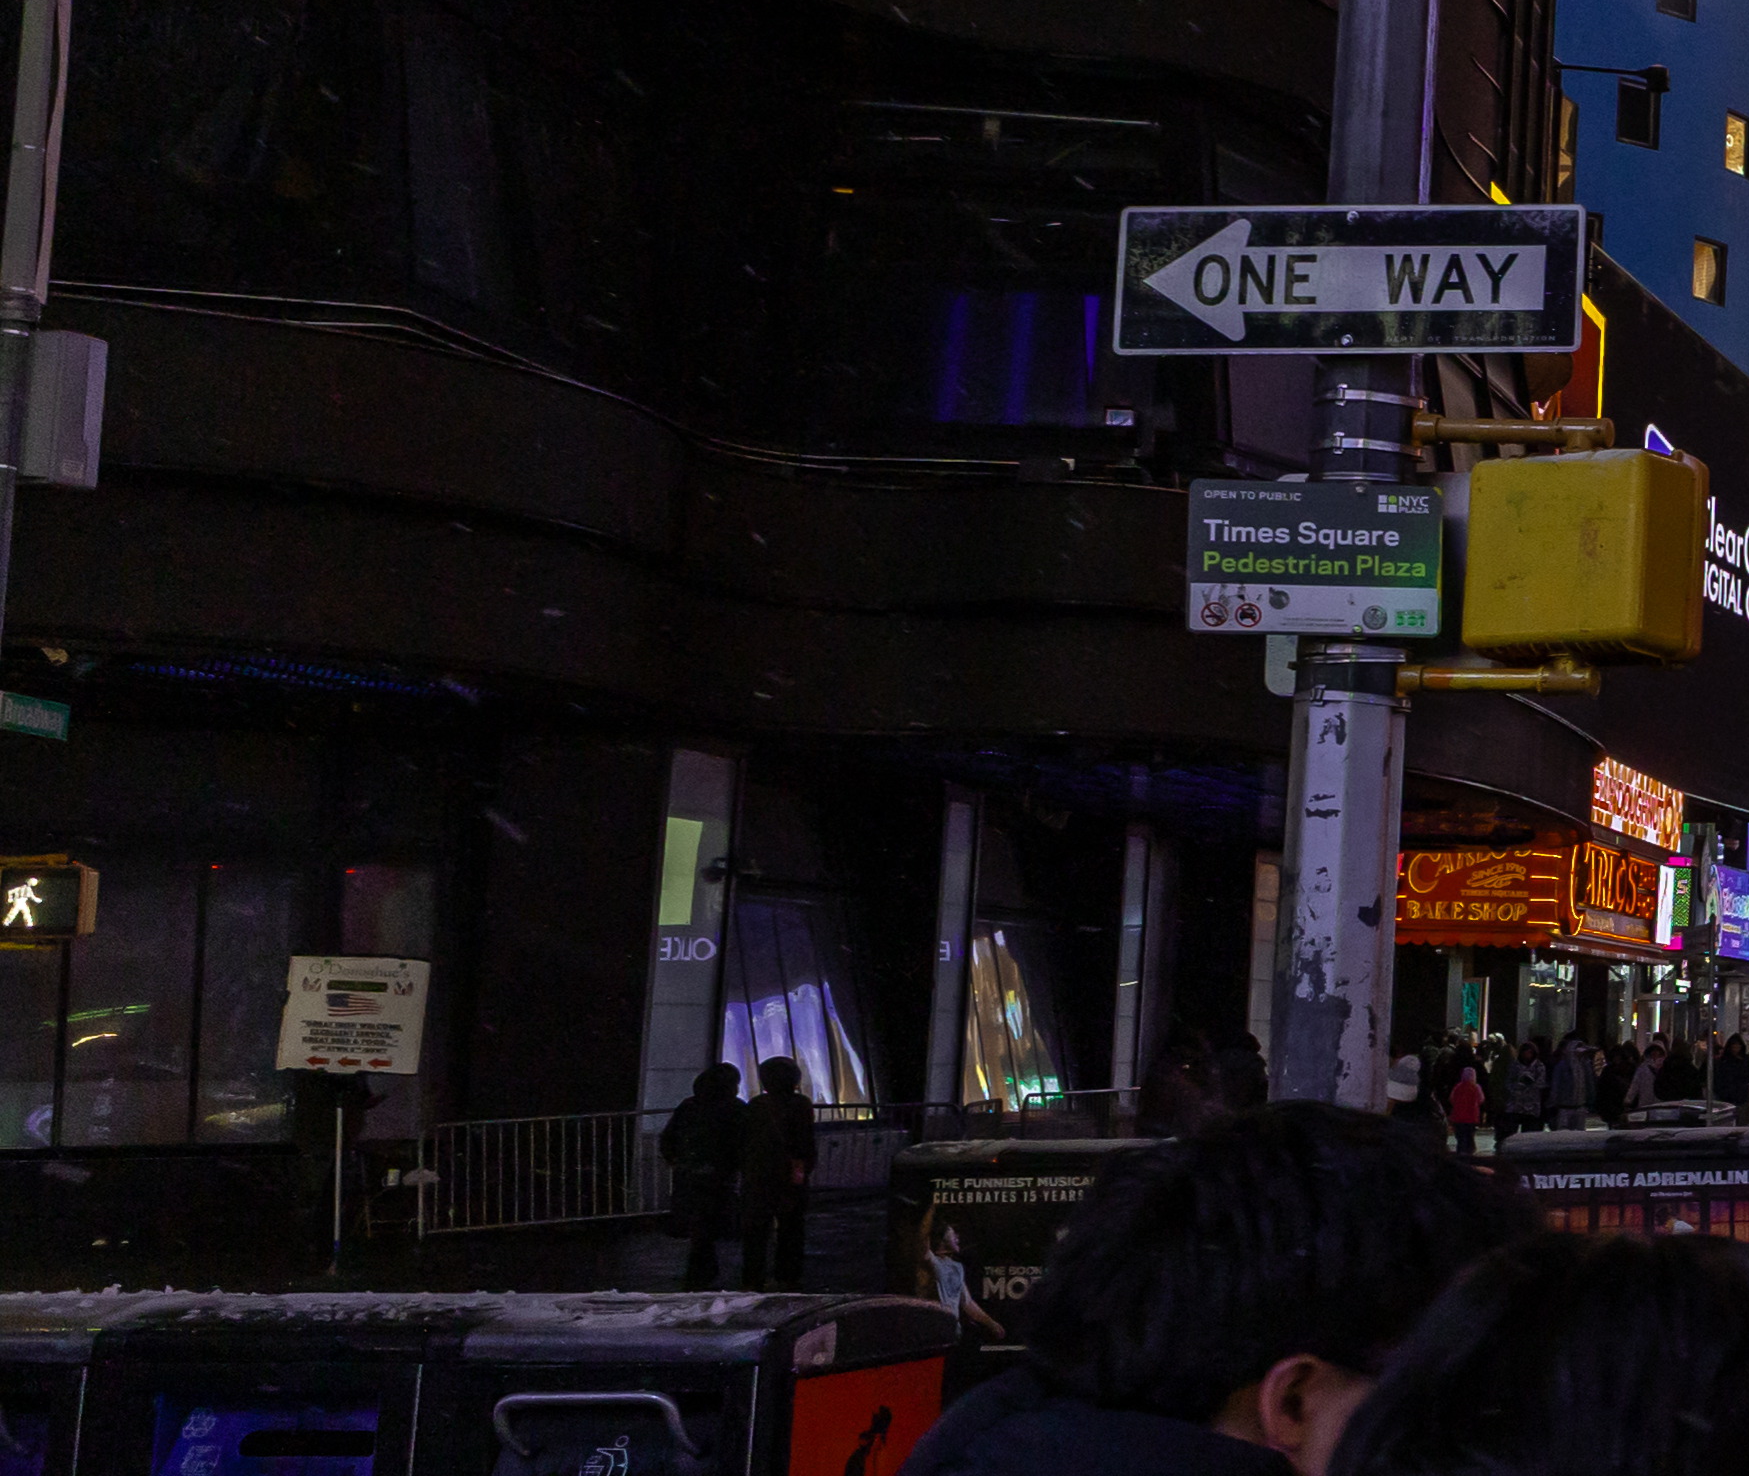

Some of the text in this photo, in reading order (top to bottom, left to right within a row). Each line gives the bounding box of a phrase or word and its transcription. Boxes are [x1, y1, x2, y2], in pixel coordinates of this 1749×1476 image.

[1192, 251, 1520, 307] ONE WAY
[1203, 489, 1303, 502] OPEN TO PUBLIC
[1398, 495, 1430, 507] NYC
[1203, 518, 1400, 550] Times Square
[1203, 550, 1427, 578] Pedestrian Plaza
[1406, 899, 1528, 922] BAKE SHOP
[931, 1177, 961, 1189] THE
[963, 1176, 1035, 1189] FUNNIEST
[1533, 1172, 1630, 1190] RIVETING
[933, 1189, 1085, 1205] CELEBRATES 15 YEARS
